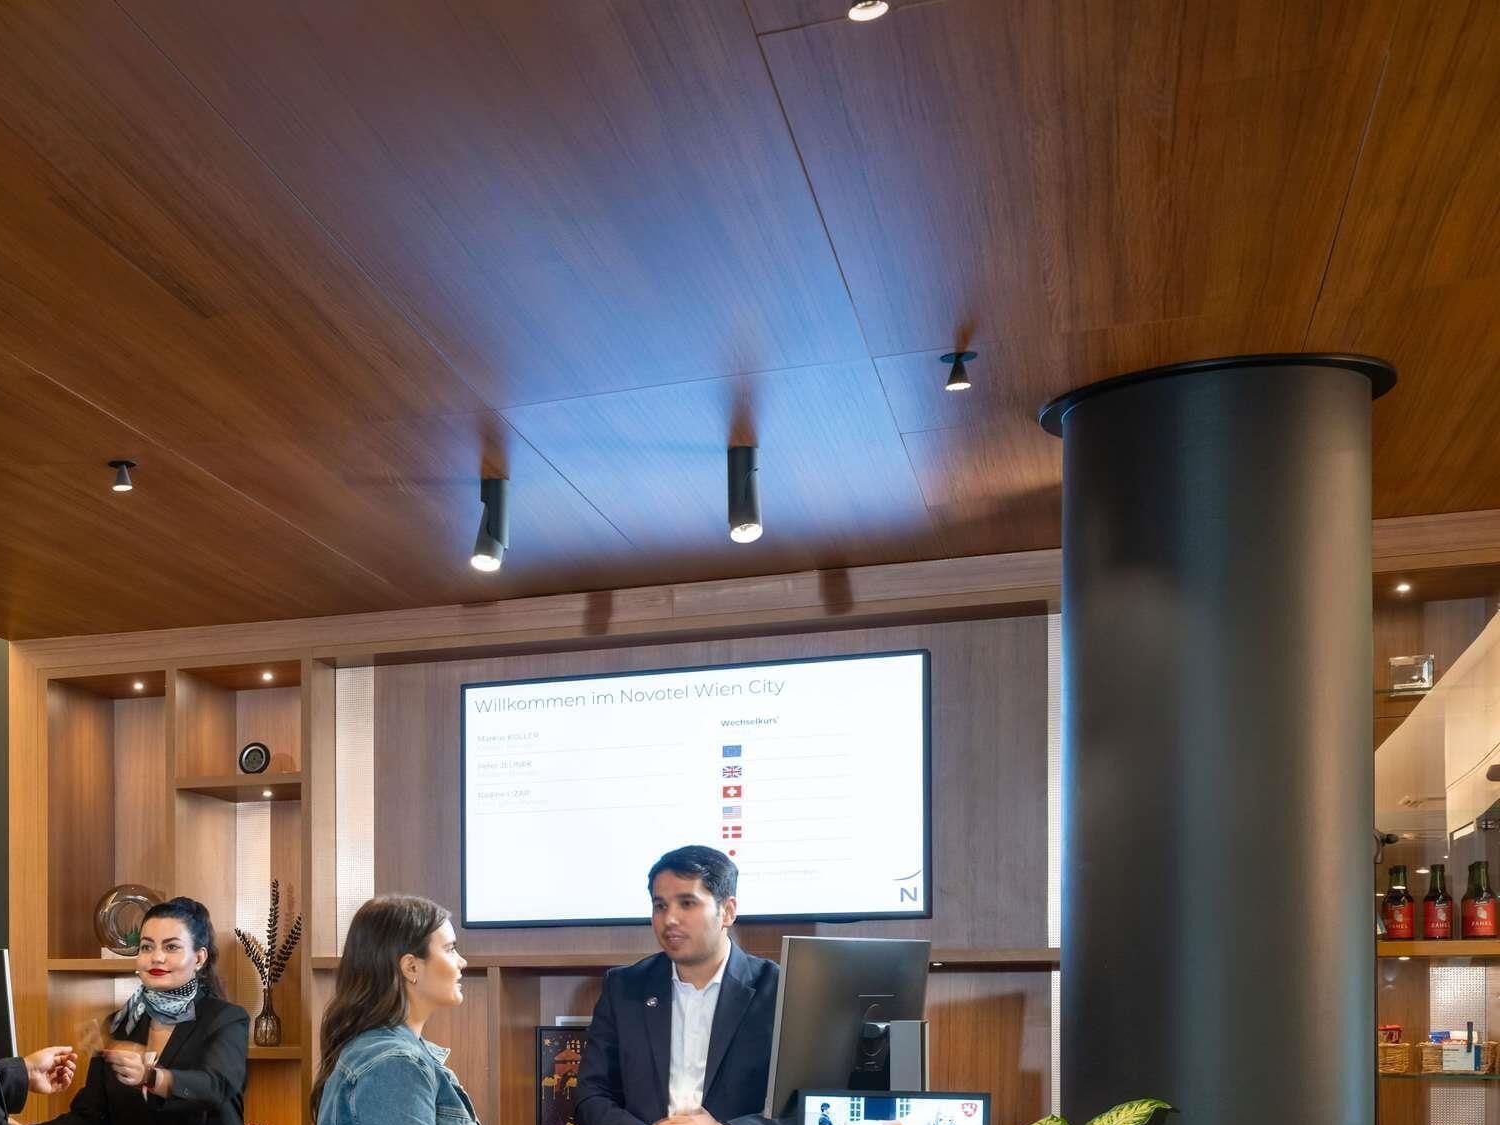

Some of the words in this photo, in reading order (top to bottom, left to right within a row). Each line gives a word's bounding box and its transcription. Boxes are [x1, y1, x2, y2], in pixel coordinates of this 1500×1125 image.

[474, 695, 586, 713] Willkommen
[591, 690, 615, 706] im
[620, 684, 689, 704] Novotel
[694, 682, 743, 698] Wien
[748, 678, 786, 697] City
[900, 887, 918, 903] N
